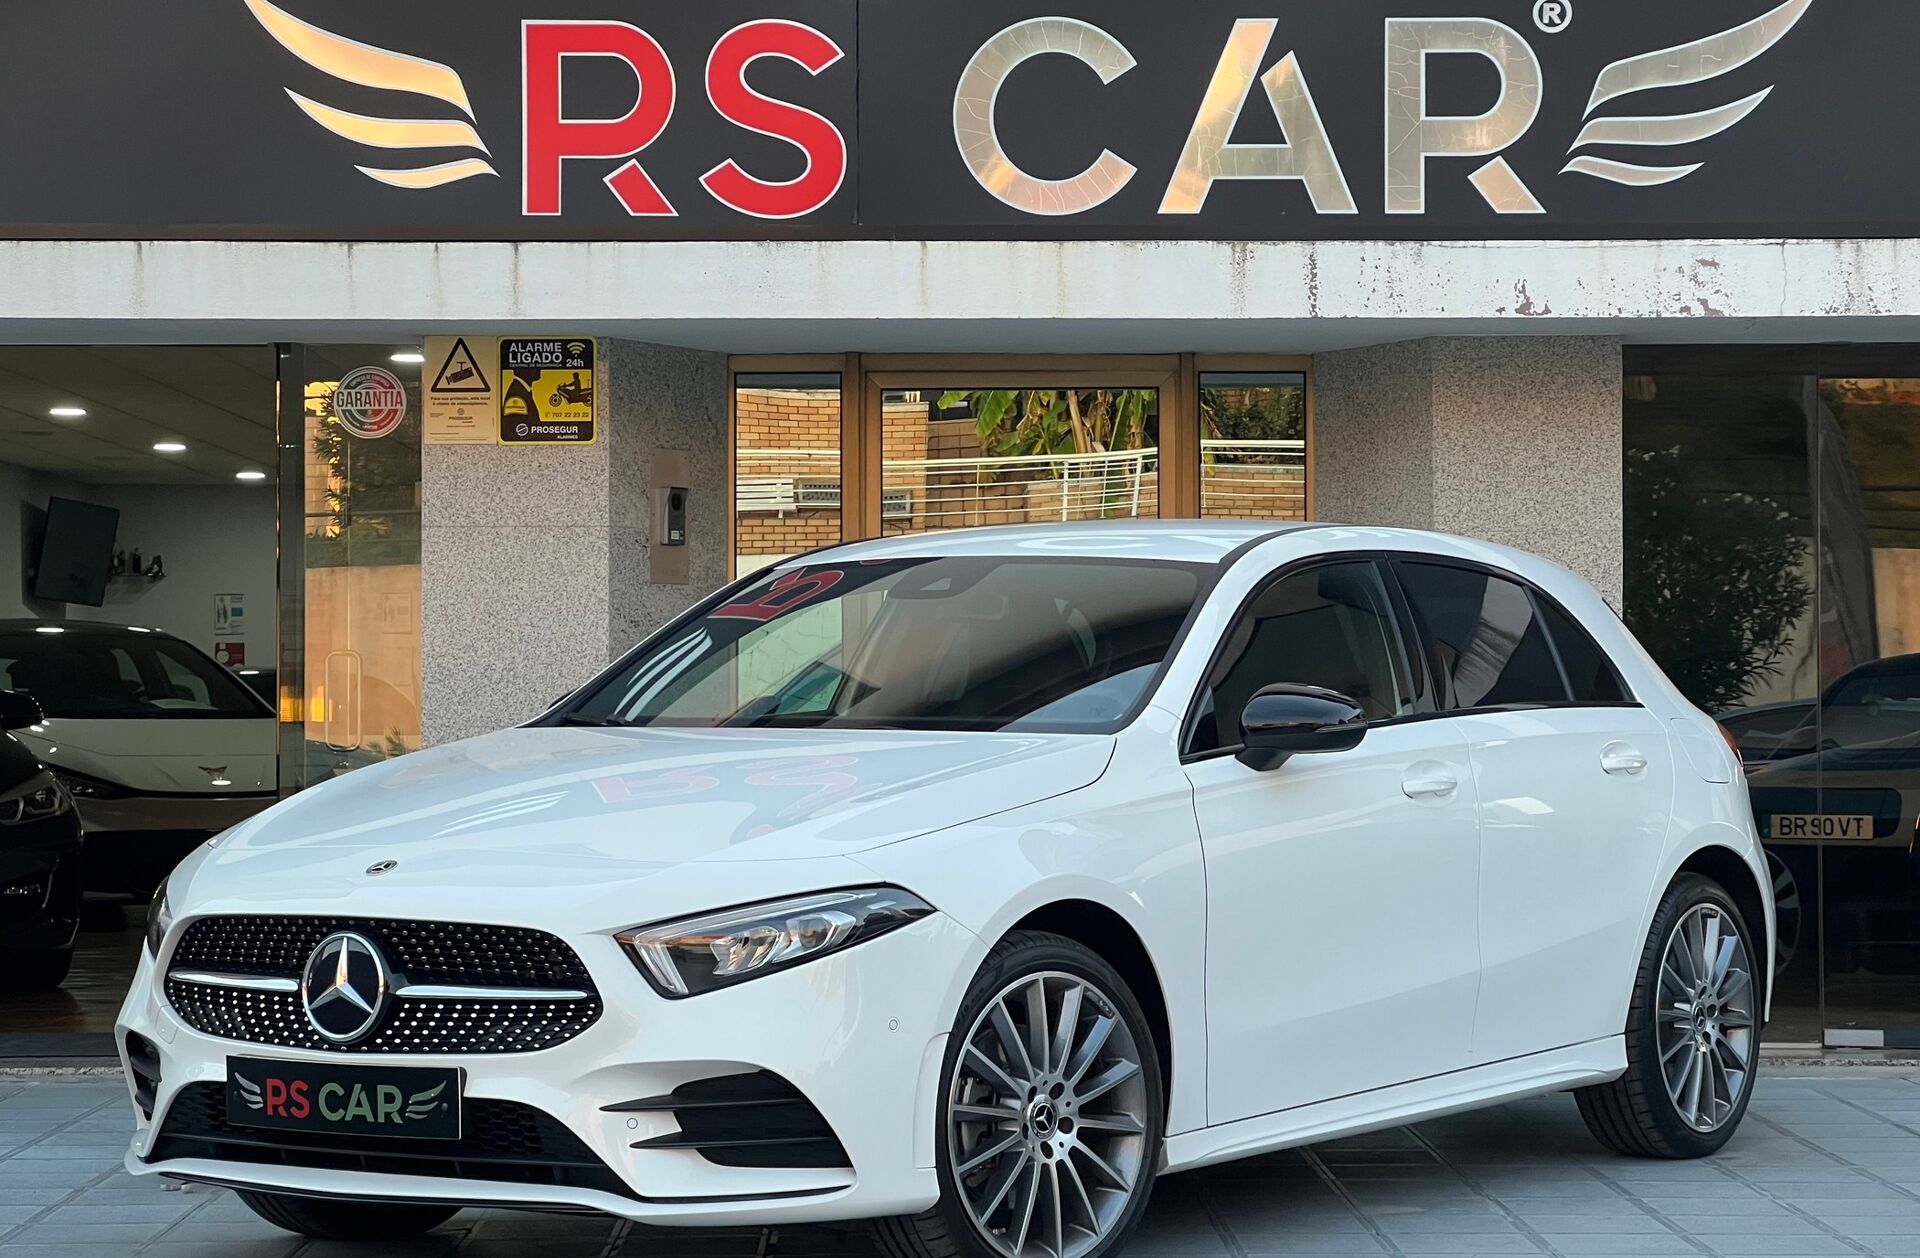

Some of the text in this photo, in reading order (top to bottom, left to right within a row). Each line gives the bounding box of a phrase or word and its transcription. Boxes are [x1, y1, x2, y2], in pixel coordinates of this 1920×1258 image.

[521, 19, 847, 219] RS
[953, 16, 1547, 216] CAR
[509, 342, 562, 352] ALARME
[508, 352, 563, 363] LIGADO
[566, 358, 584, 367] 24h
[336, 390, 404, 408] GARANTIA
[530, 425, 578, 434] PROSEGUR
[1779, 817, 1807, 837] BR
[265, 1078, 404, 1124] RS CAR
